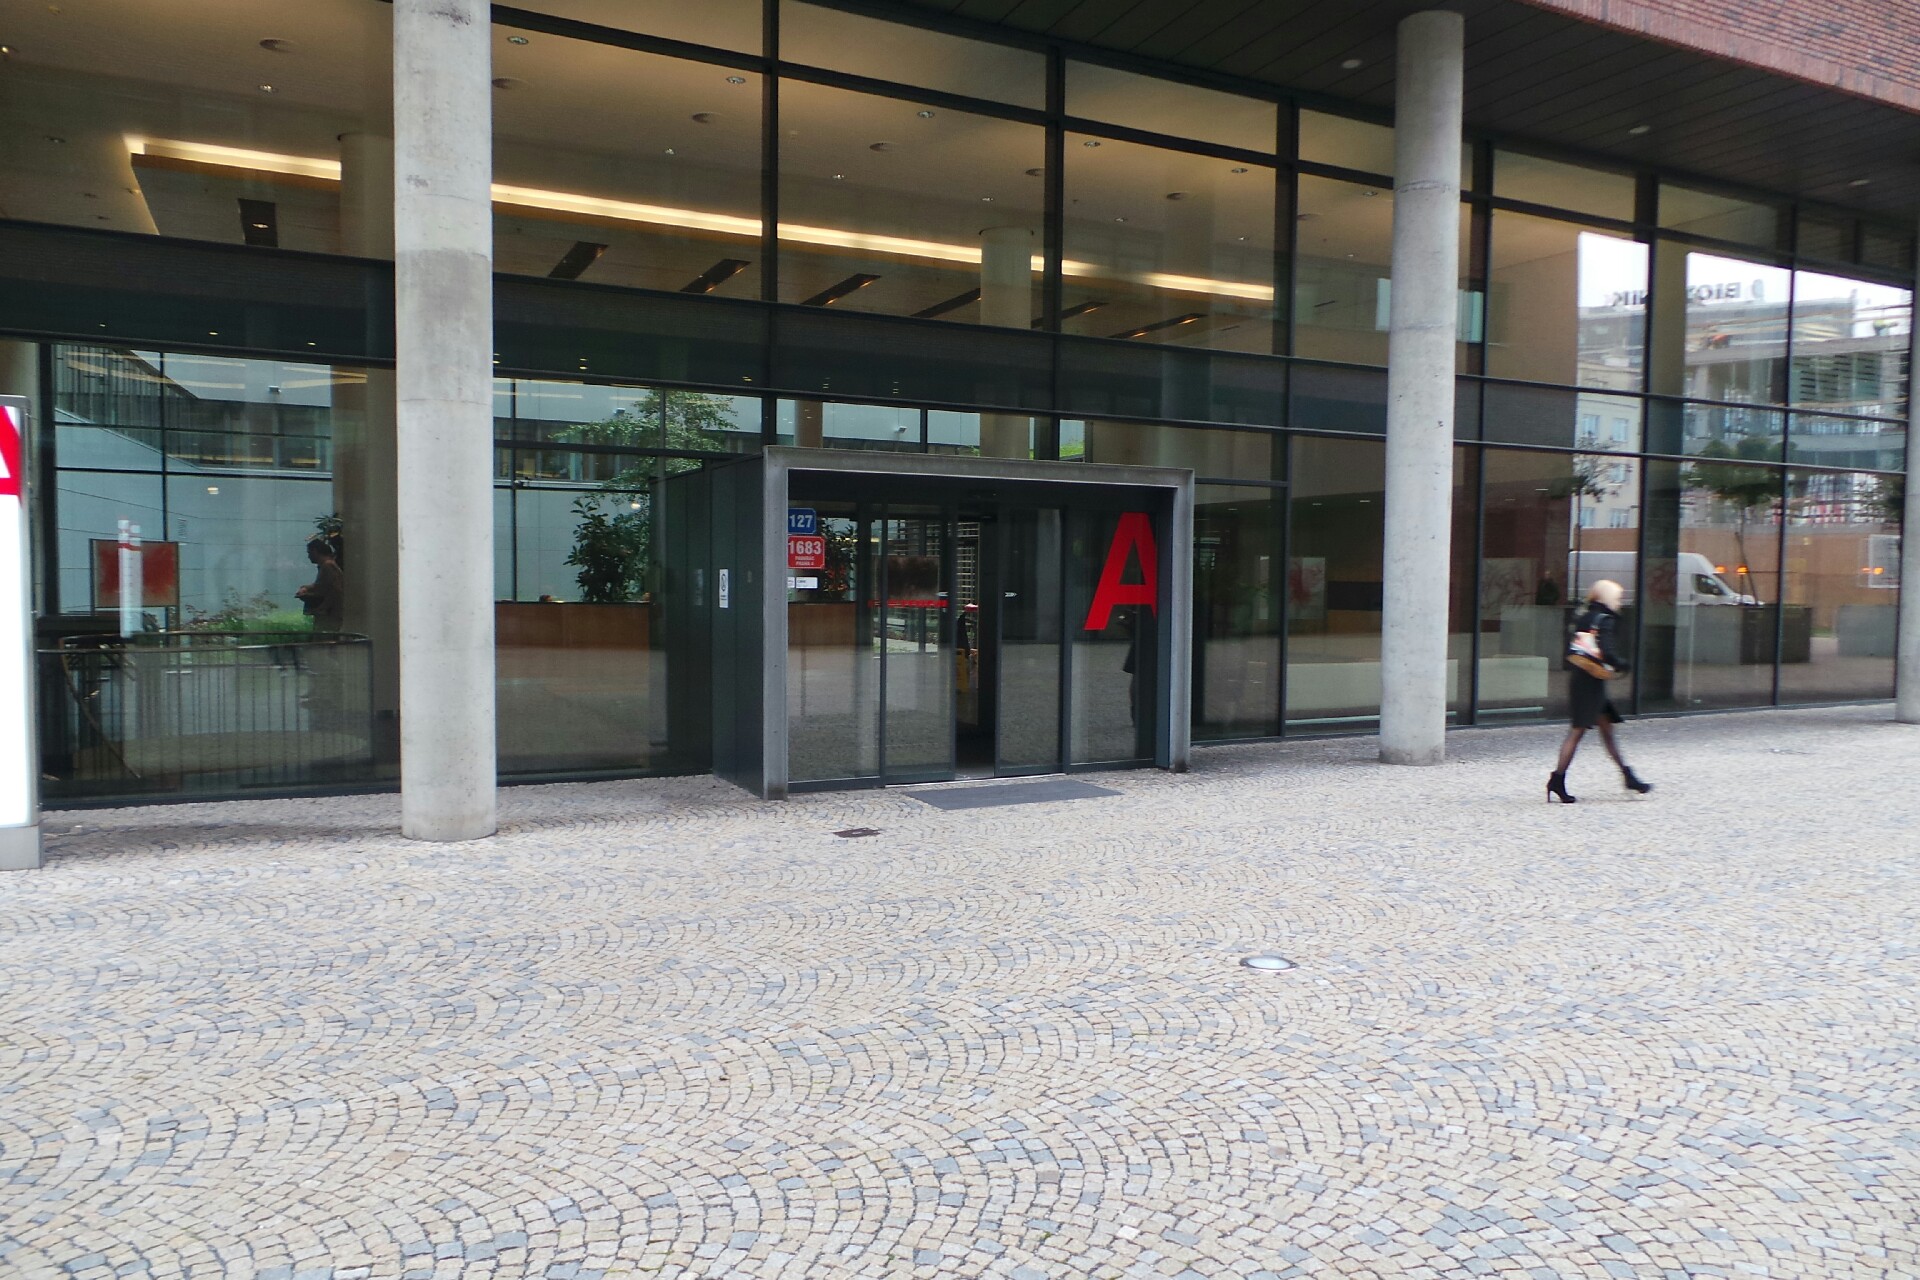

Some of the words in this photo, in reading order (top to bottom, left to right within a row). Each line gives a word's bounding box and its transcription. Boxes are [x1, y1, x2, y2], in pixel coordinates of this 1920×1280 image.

[789, 514, 813, 528] 127
[788, 540, 822, 555] 1683
[1083, 512, 1157, 630] A
